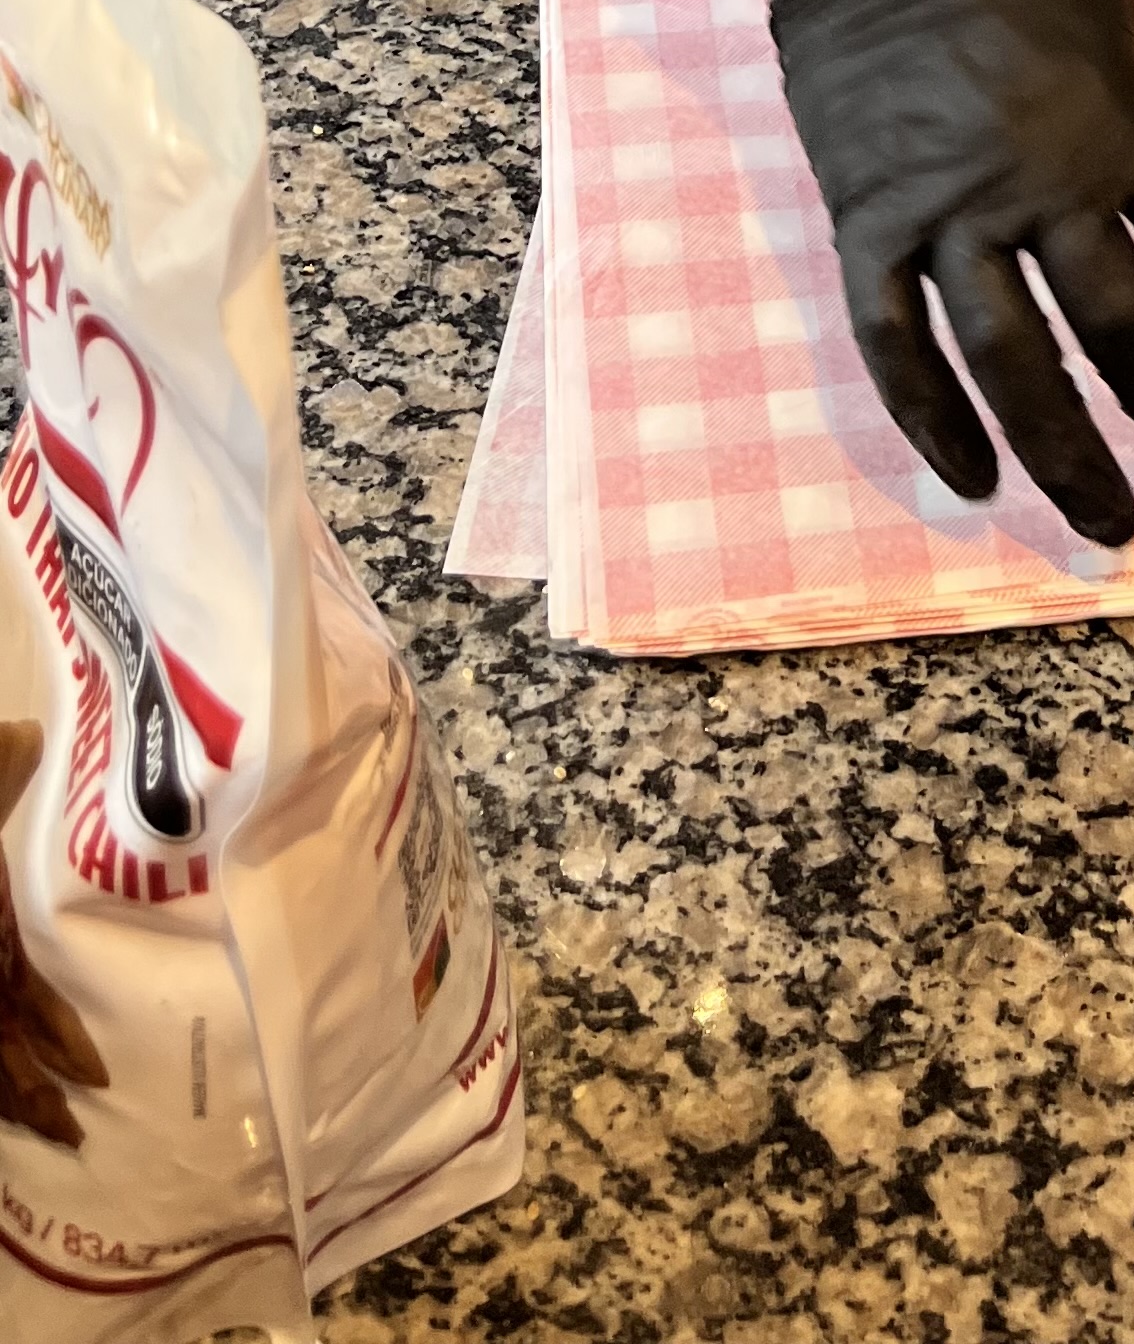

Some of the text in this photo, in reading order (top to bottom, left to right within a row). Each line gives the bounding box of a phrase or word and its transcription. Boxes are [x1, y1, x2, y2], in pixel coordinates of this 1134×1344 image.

[67, 561, 138, 682] DICIONADO
[63, 634, 112, 820] SWEET
[67, 786, 210, 904] CHILI
